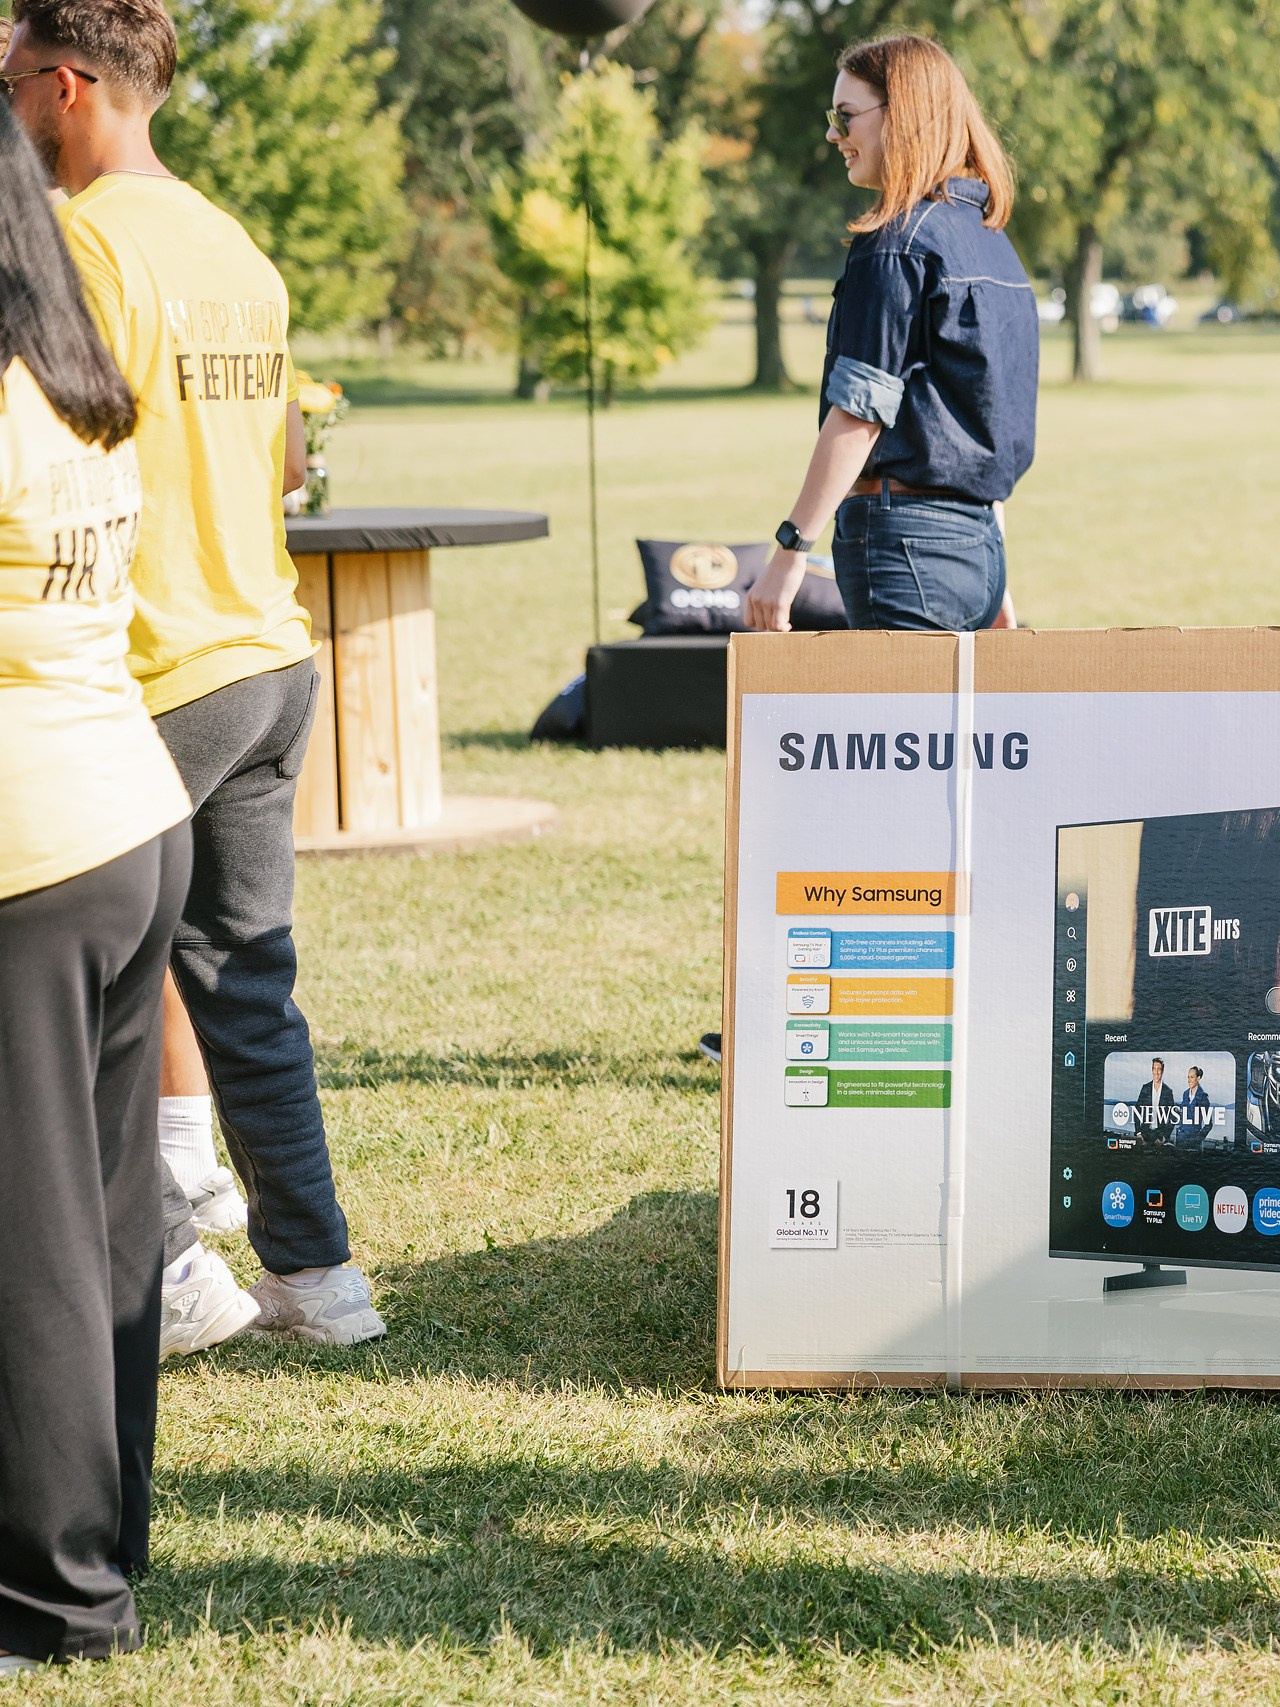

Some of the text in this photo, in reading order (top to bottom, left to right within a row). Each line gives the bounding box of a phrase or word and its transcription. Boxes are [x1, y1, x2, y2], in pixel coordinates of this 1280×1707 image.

[43, 527, 97, 600] HR
[779, 732, 1029, 771] SAMSUNG
[804, 886, 942, 907] Why Samsung
[1153, 909, 1241, 953] XITE HITS
[896, 939, 923, 947] including
[840, 946, 867, 954] Samsung
[1104, 1034, 1128, 1042] Recent
[856, 1047, 884, 1055] Samsung
[1113, 1105, 1226, 1125] abc NEWS LIVE
[1118, 1138, 1137, 1146] Samsung
[786, 1189, 820, 1219] 18
[1143, 1209, 1165, 1218] Samsung
[1217, 1204, 1245, 1216] NETFLIX
[1104, 1213, 1132, 1222] SmartThings
[1182, 1215, 1203, 1224] Live TV
[776, 1228, 829, 1236] Global No.1 TV
